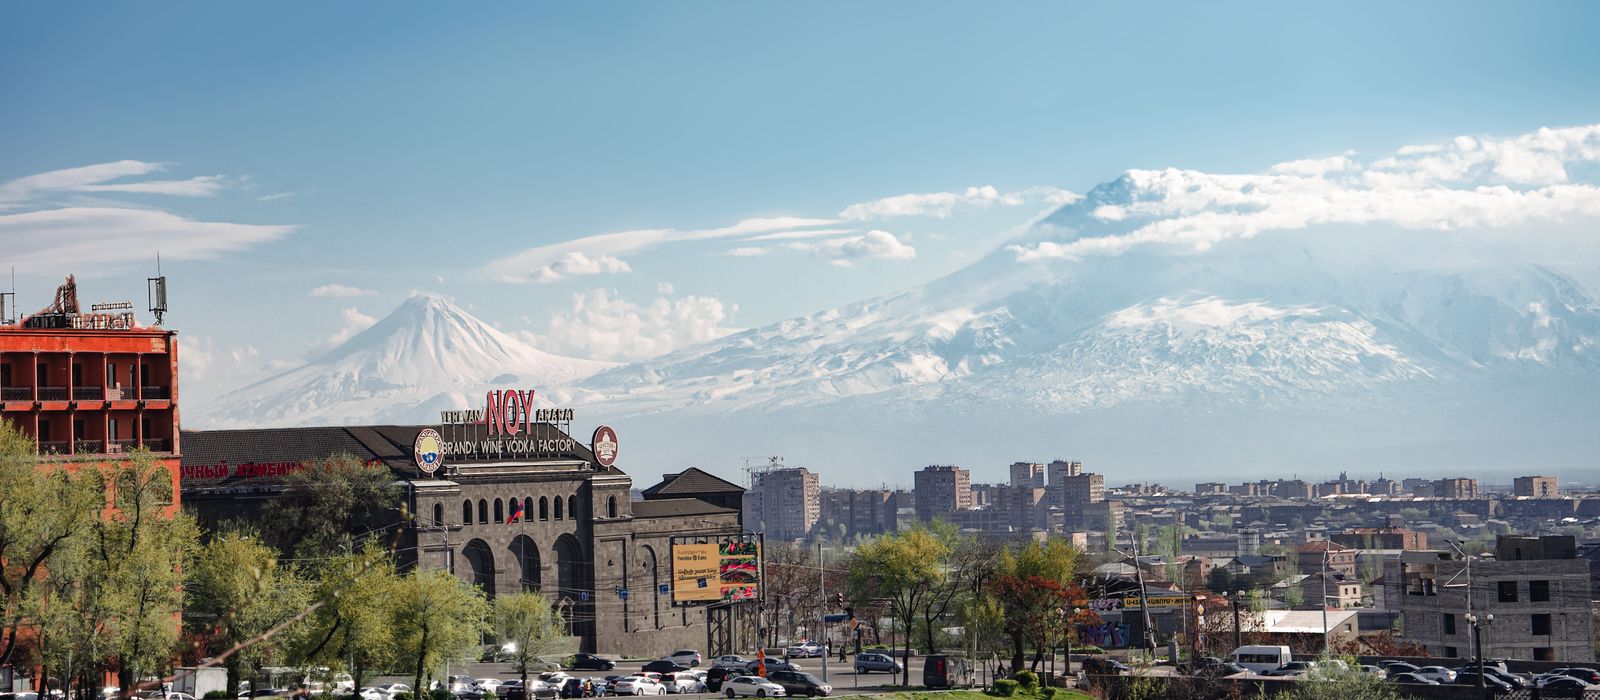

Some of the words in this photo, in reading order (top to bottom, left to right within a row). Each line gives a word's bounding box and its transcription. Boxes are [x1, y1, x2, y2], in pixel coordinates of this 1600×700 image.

[487, 389, 535, 436] NOY
[536, 408, 575, 421] ARARAT
[443, 441, 477, 455] BRANDY
[480, 440, 503, 454] WINE
[506, 439, 535, 453] VODKA
[538, 438, 577, 452] FACTORY
